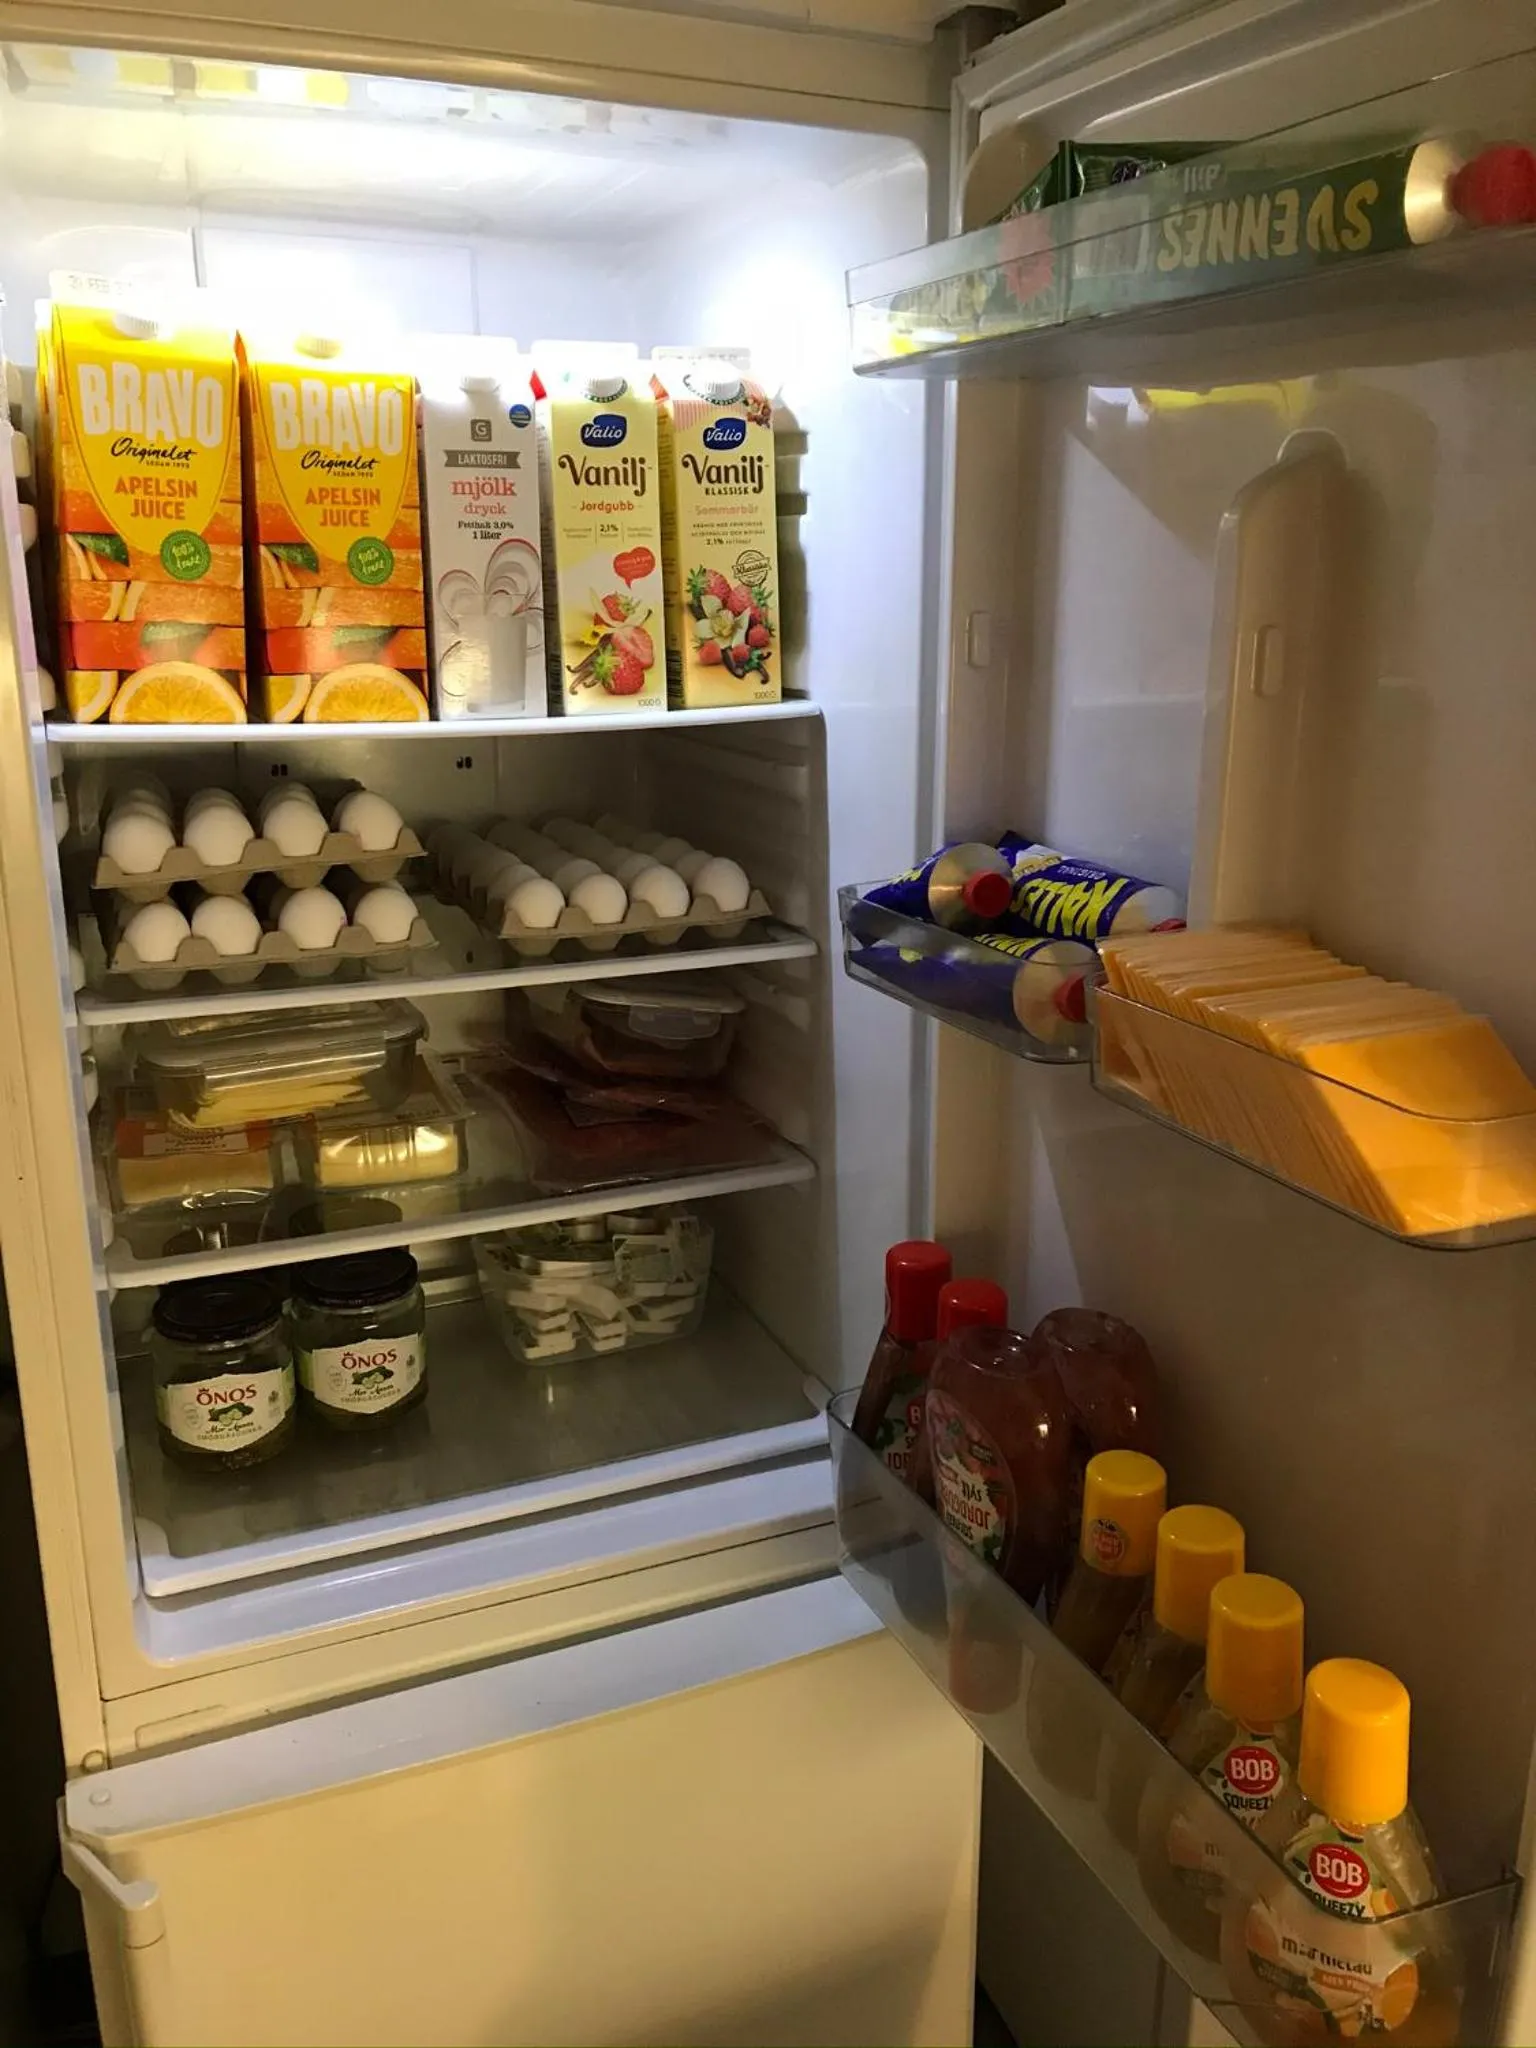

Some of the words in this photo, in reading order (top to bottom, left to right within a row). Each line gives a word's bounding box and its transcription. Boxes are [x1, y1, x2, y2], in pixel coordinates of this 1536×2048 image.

[1183, 163, 1221, 194] dill
[1156, 178, 1379, 273] SVENNES
[77, 361, 224, 449] BRAVO
[269, 379, 405, 457] BRAVO
[583, 423, 624, 440] Valio
[706, 426, 743, 444] Valio
[457, 452, 508, 466] LAKTOSFRI
[114, 476, 199, 499] APELSIN
[305, 487, 381, 506] APELSIN
[451, 476, 517, 500] mjölk
[704, 487, 749, 496] KLASSISK
[130, 498, 186, 520] JUICE
[319, 509, 370, 527] JUICE
[463, 502, 507, 516] dryck
[579, 500, 635, 514] Jordgubb
[480, 530, 502, 541] liter
[1010, 877, 1131, 940] KALLES
[341, 1348, 397, 1370] ÖNOS
[196, 1383, 257, 1406] ÖNOS
[1230, 1757, 1275, 1782] BOB
[1222, 1792, 1273, 1811] SQUEEZ
[1315, 1852, 1363, 1887] BOB
